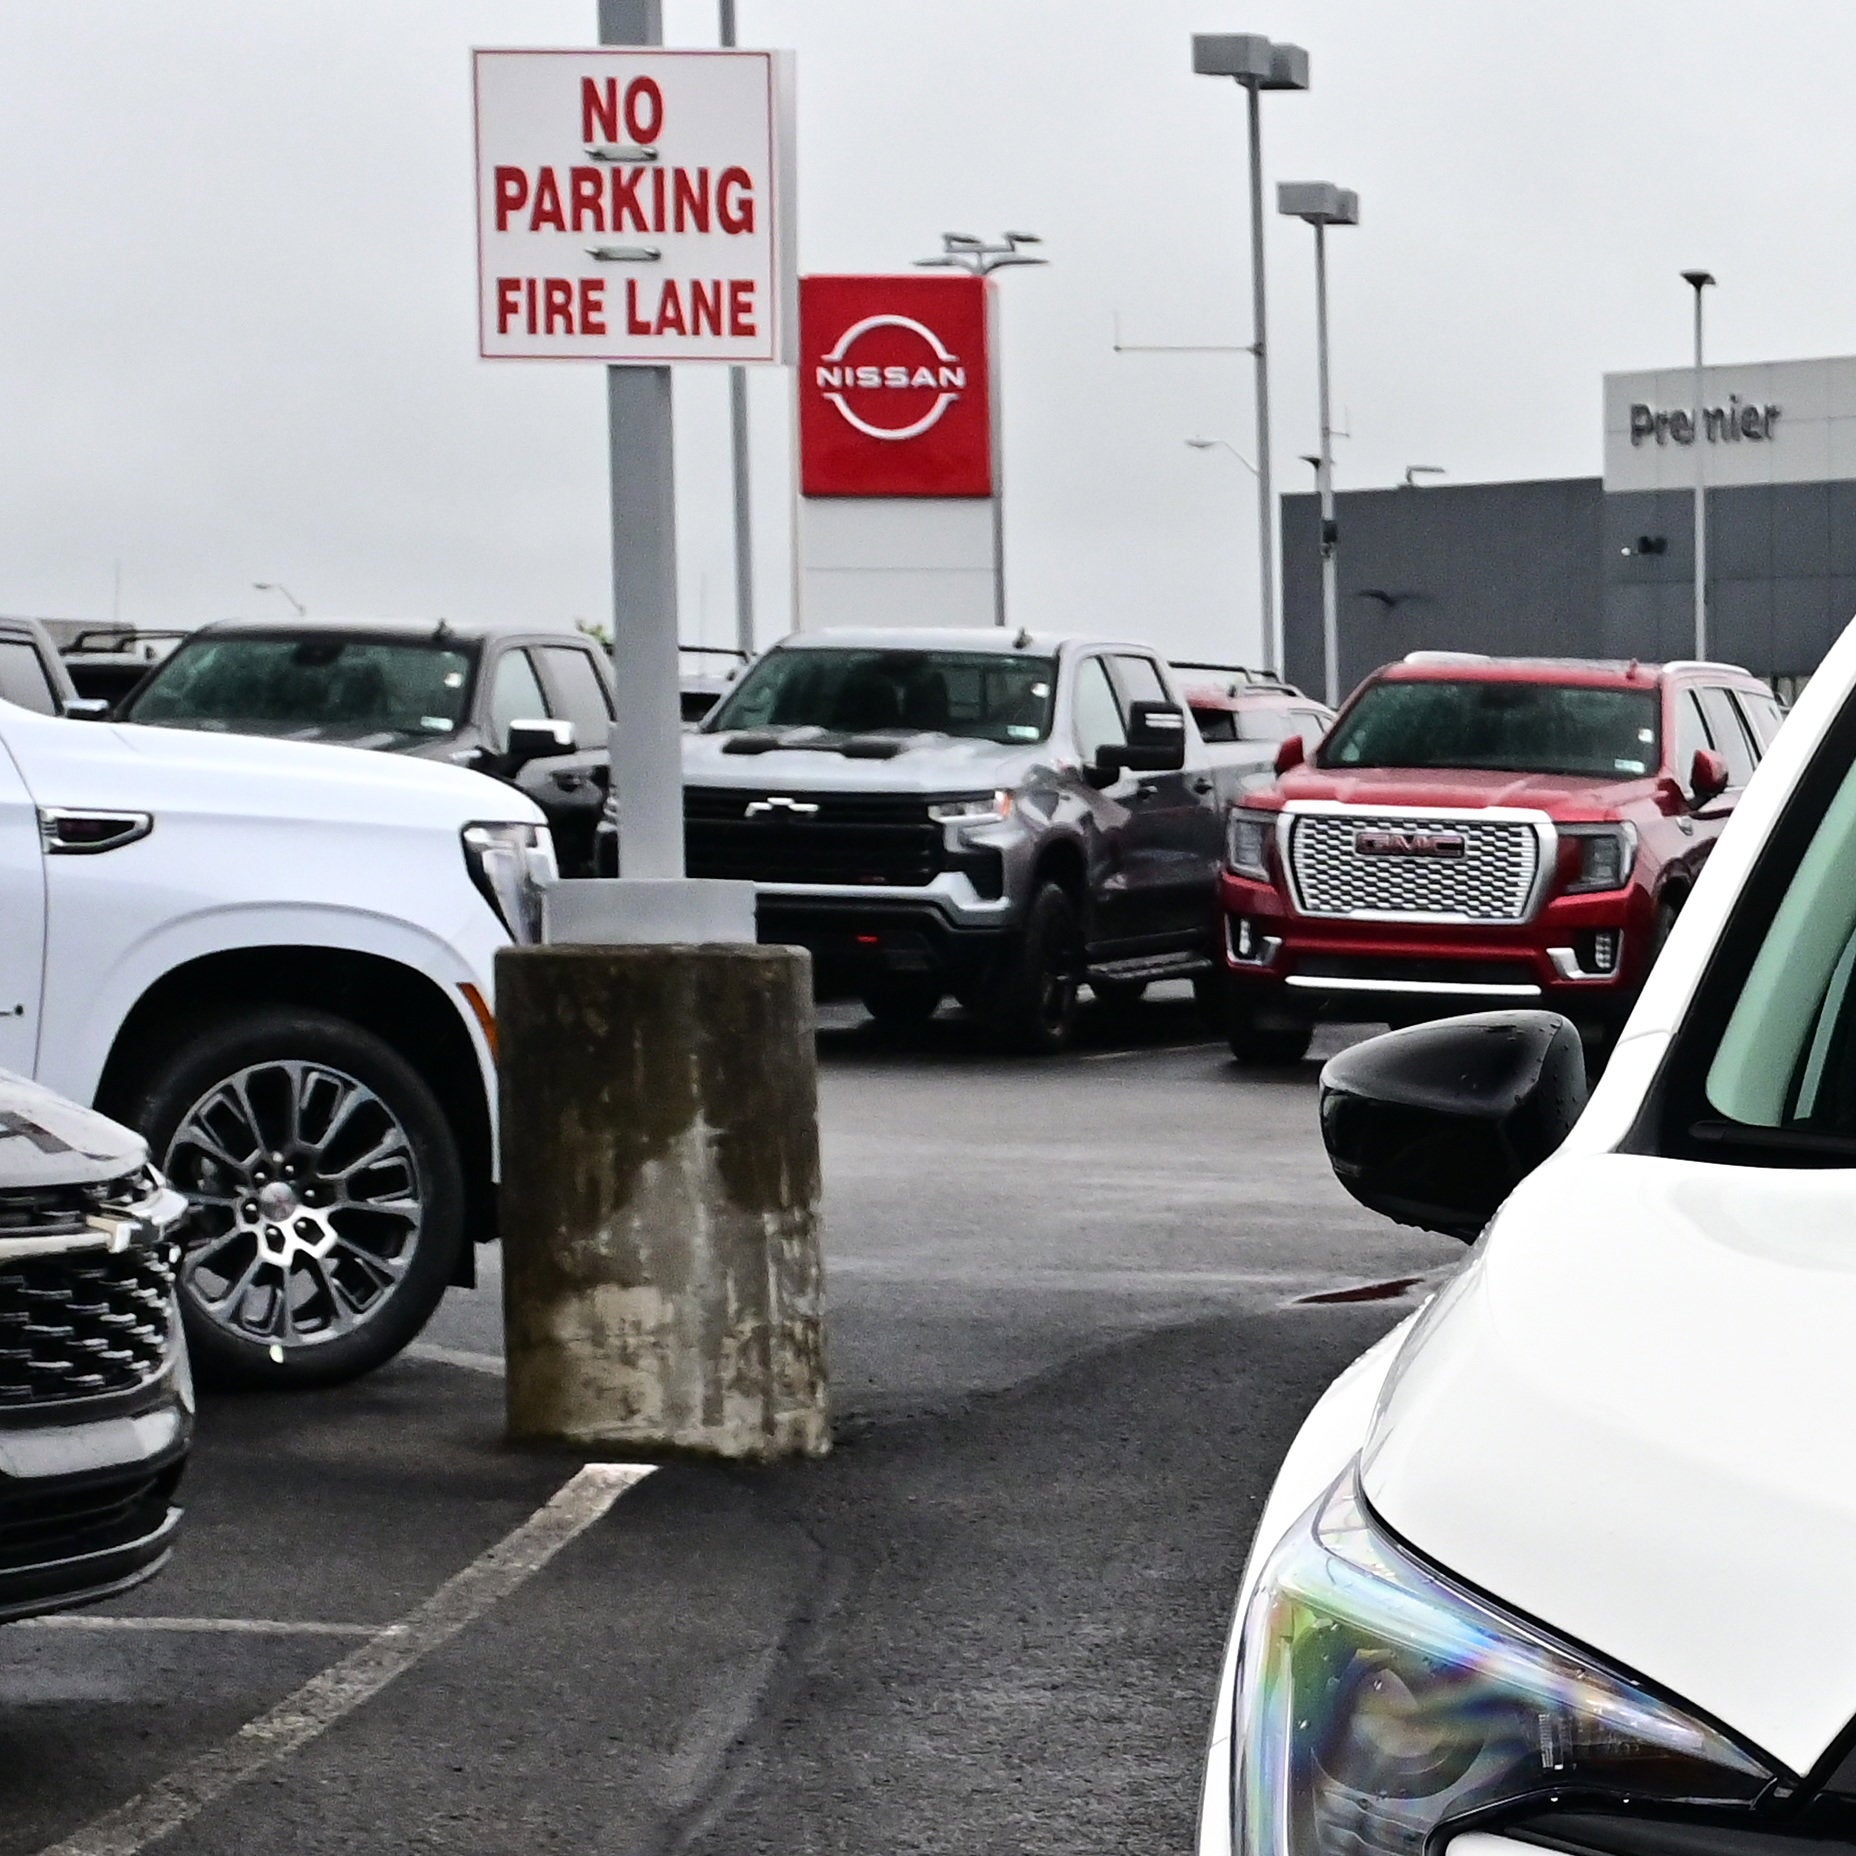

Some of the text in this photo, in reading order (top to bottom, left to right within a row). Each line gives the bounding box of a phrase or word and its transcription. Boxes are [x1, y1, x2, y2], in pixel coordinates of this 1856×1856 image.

[581, 75, 664, 145] NO
[494, 165, 754, 235] PARKING
[497, 277, 757, 337] FIRE LANE
[815, 366, 966, 389] NISSAN
[1630, 394, 1781, 447] Premier
[1355, 832, 1464, 857] GMC
